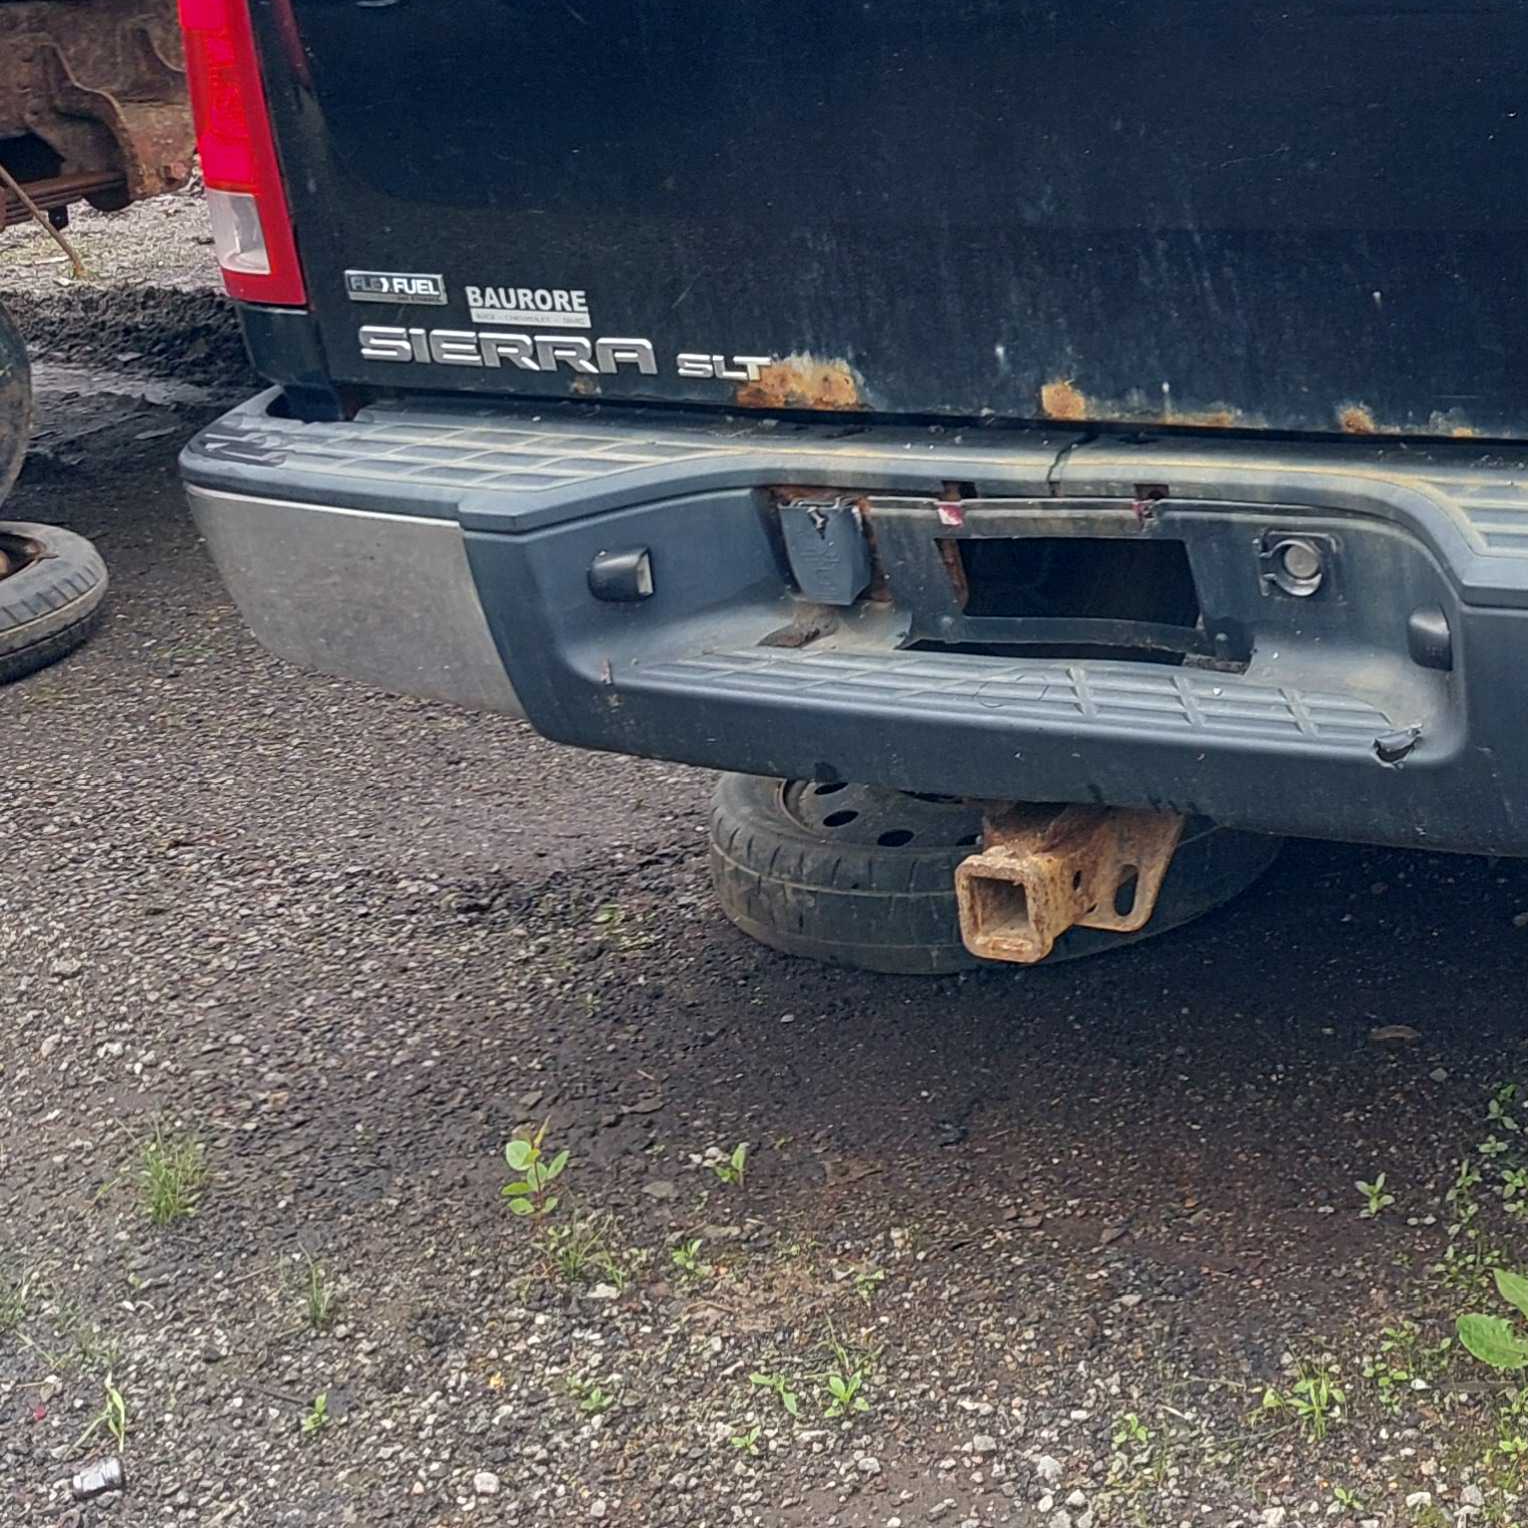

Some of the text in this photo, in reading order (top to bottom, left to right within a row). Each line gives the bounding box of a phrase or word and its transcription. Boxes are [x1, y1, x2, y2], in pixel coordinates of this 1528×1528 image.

[464, 286, 589, 313] BAURORE
[359, 325, 771, 382] SIERRA SLT
